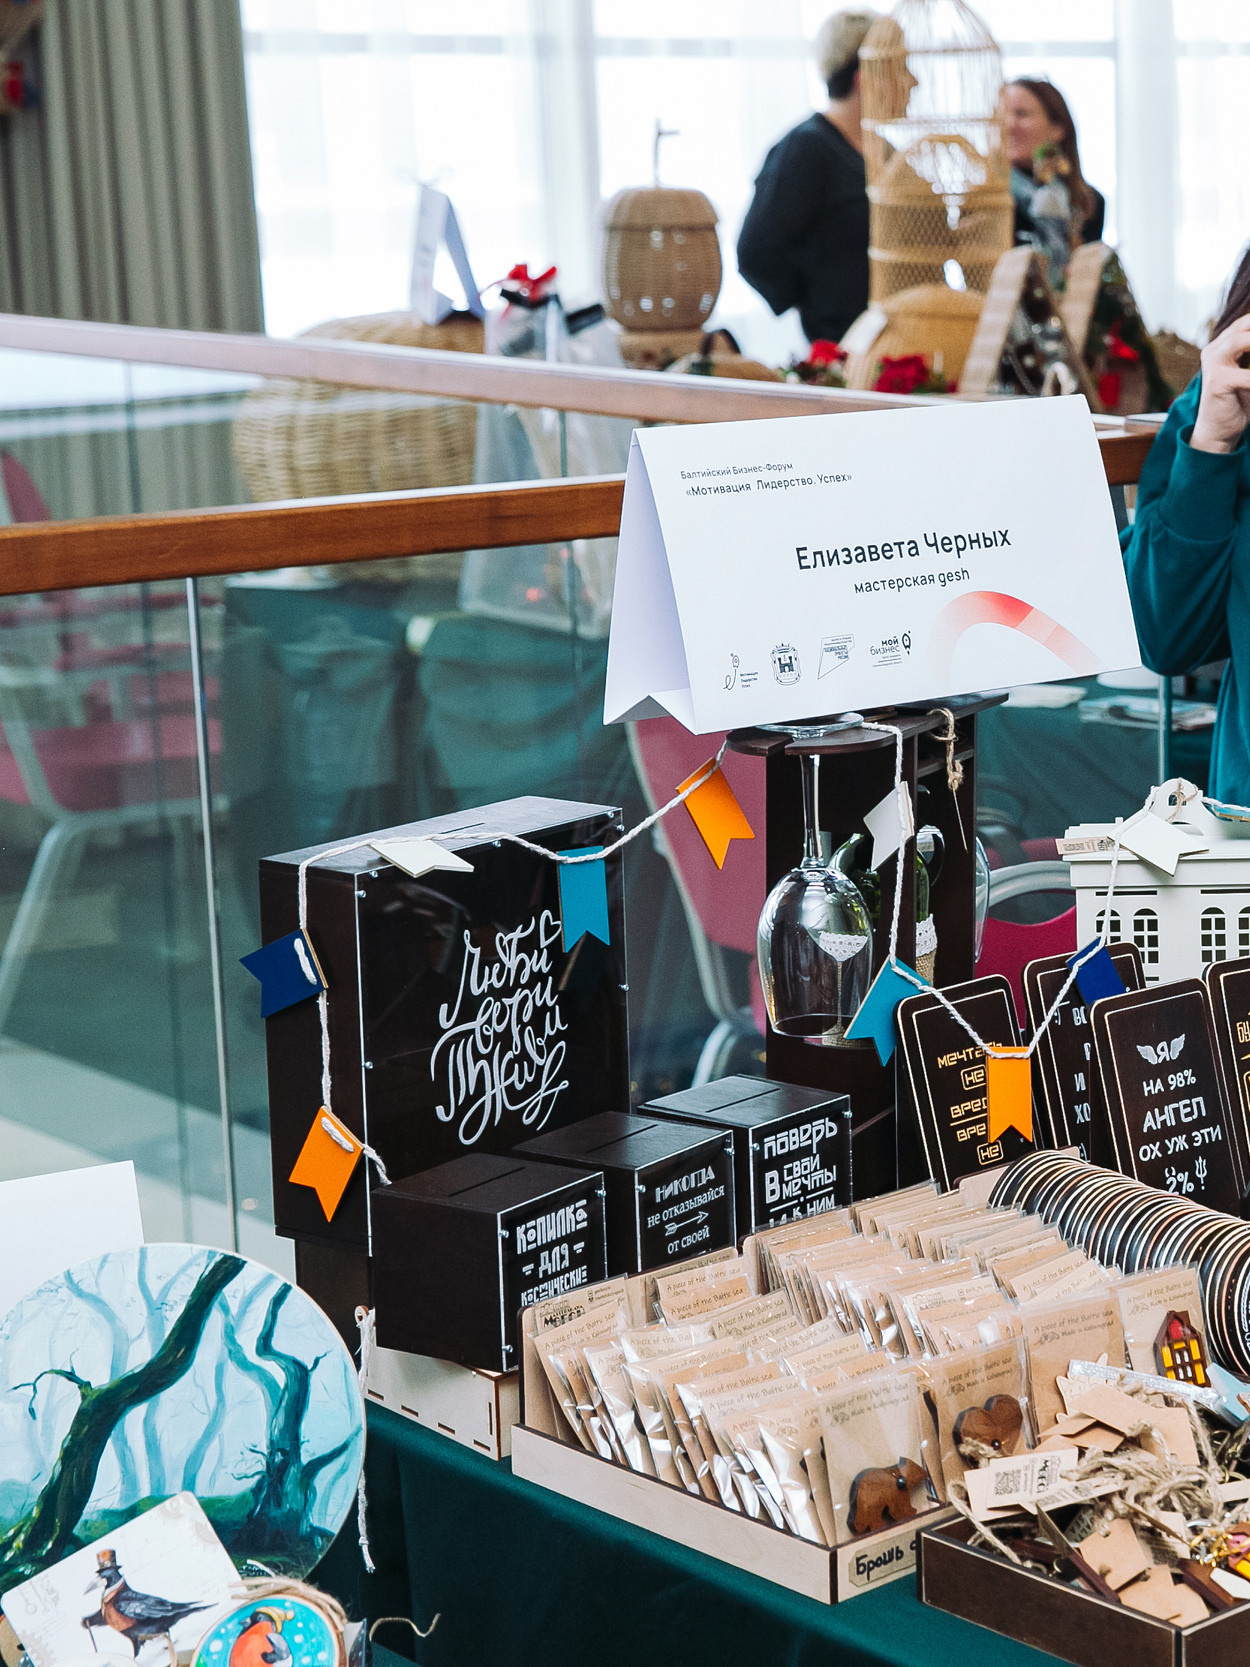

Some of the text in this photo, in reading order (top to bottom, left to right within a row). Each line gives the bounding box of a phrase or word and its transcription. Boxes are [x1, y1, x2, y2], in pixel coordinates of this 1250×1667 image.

[680, 463, 794, 480] Балтийский Бизнес-Форум
[686, 481, 752, 497] «Мотивация
[817, 473, 853, 485] Успех»
[796, 529, 1012, 570] Елизавета Черных
[854, 567, 970, 594] мастерская gesh
[870, 645, 900, 656] бизнес
[881, 636, 899, 647] мой
[1156, 1041, 1170, 1064] Я
[1142, 1068, 1197, 1097] НА 98%
[1143, 1096, 1207, 1133] АНГЕЛ
[763, 1117, 838, 1160] ПОВЕРЬ
[1138, 1124, 1222, 1162] ОХ УЖ ЭТИ
[655, 1165, 716, 1203] НИКОГДА
[765, 1169, 780, 1204] В
[782, 1165, 837, 1200] МЕЧТЫ
[647, 1185, 725, 1229] не отказывайся
[806, 1193, 836, 1217] НИМ
[516, 1199, 588, 1255] КОПИЛКА
[667, 1225, 711, 1255] от своей
[539, 1243, 570, 1279] ДЛЯ
[688, 1277, 695, 1286] of
[696, 1275, 706, 1284] the
[729, 1267, 741, 1276] sea
[1154, 1287, 1165, 1296] the
[1182, 1279, 1193, 1288] sea
[676, 1303, 692, 1314] piece
[692, 1299, 700, 1309] of
[702, 1296, 712, 1305] the
[713, 1291, 731, 1303] Baltic
[733, 1287, 744, 1296] sea
[737, 1313, 744, 1323] of
[745, 1308, 755, 1317] the
[756, 1303, 774, 1315] Baltic
[774, 1299, 785, 1307] sea
[550, 1335, 566, 1348] piece
[567, 1331, 574, 1340] of
[574, 1326, 585, 1335] the
[604, 1312, 616, 1322] sea
[787, 1320, 798, 1329] sea
[1034, 1325, 1040, 1334] A
[1058, 1318, 1066, 1327] of
[1067, 1316, 1079, 1325] the
[1081, 1311, 1100, 1322] Baltic
[1101, 1309, 1114, 1317] sea
[849, 1343, 860, 1351] sea
[709, 1381, 799, 1411] A piece of the Baltic sea
[716, 1383, 724, 1393] of
[726, 1381, 738, 1390] the
[740, 1376, 759, 1388] Baltic
[761, 1373, 773, 1382] sea
[855, 1546, 904, 1581] Брошь
